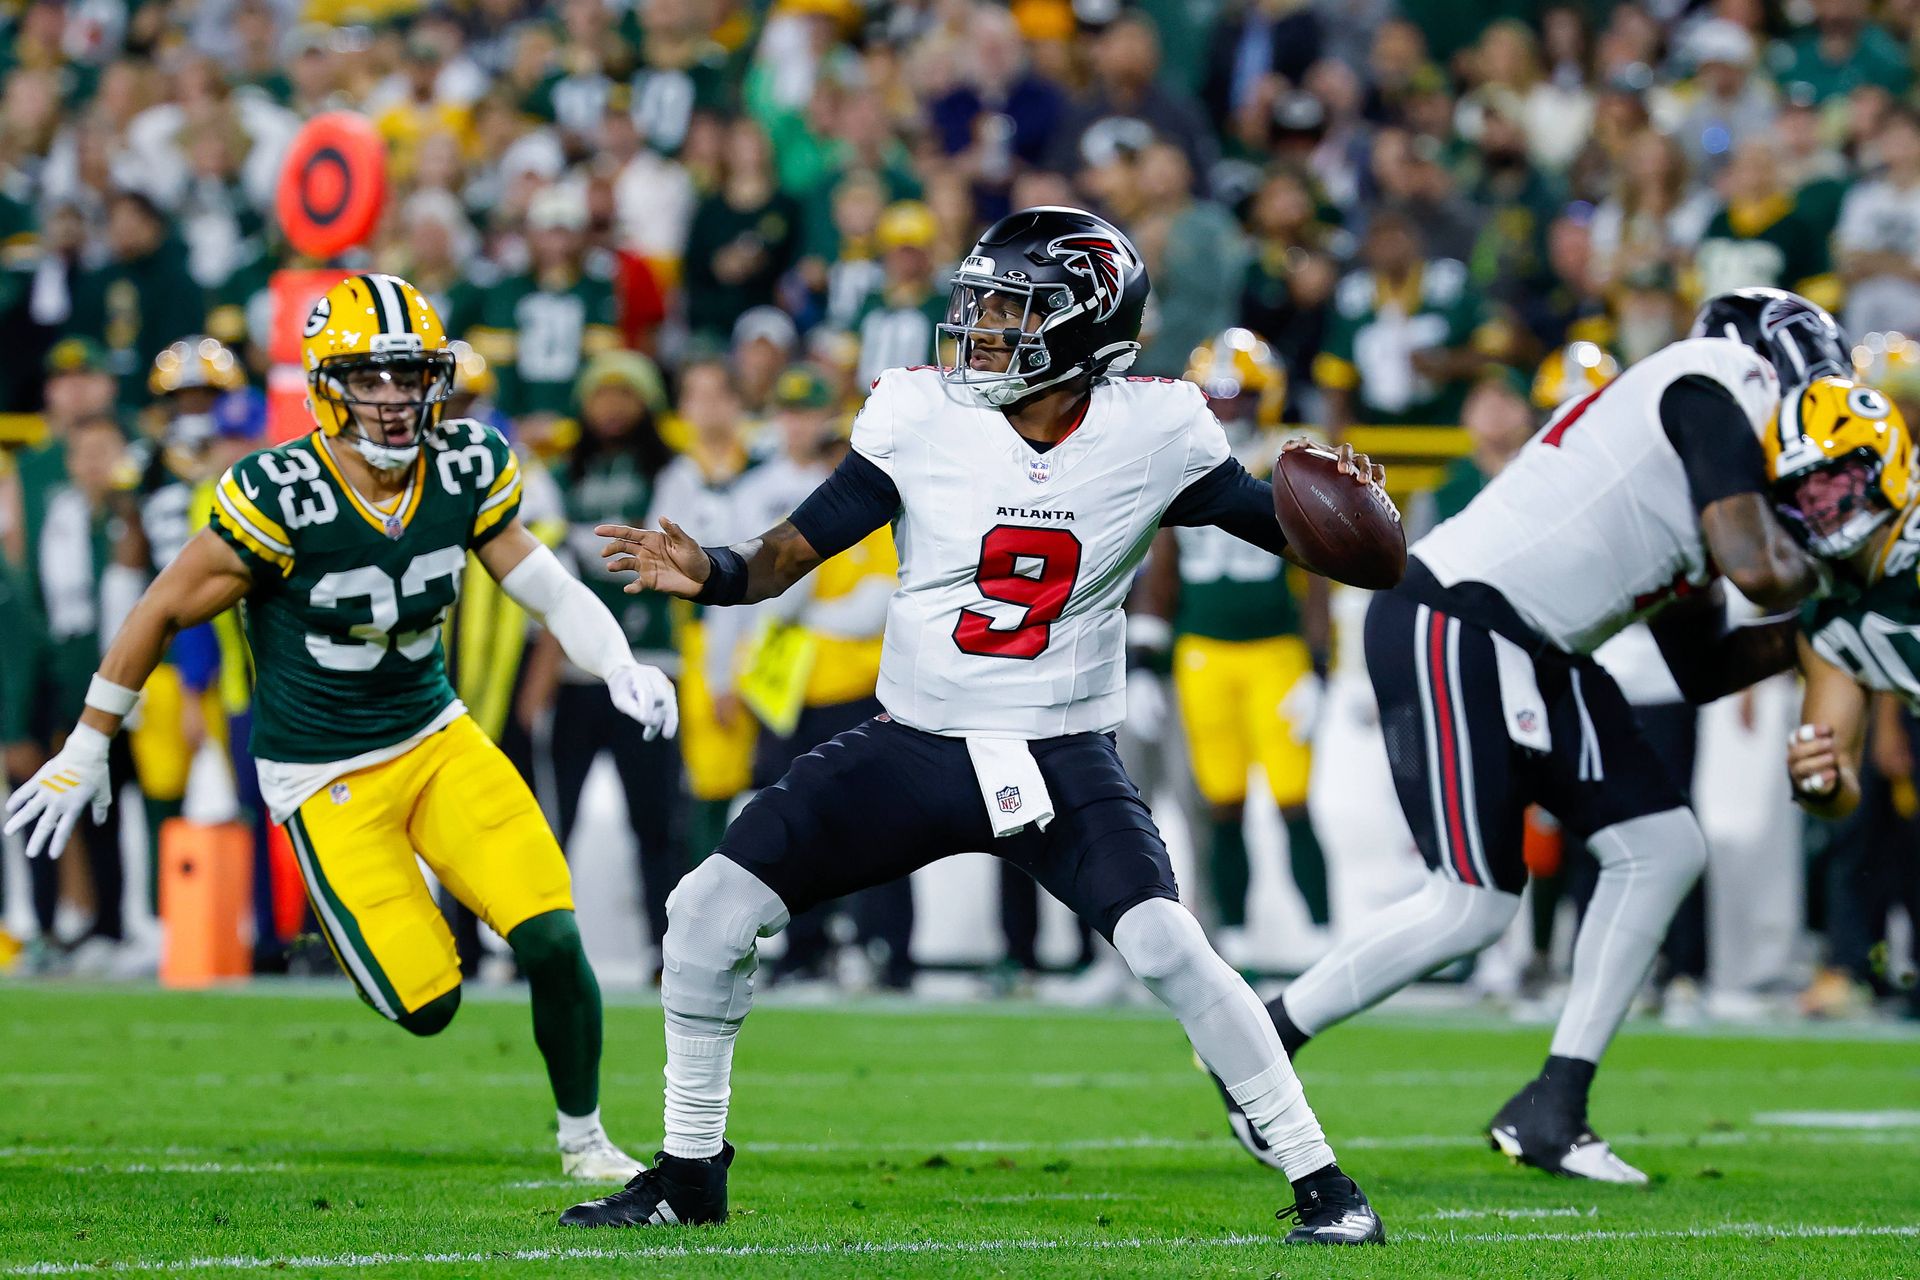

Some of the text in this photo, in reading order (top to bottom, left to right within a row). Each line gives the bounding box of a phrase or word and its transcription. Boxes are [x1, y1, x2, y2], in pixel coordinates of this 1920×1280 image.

[257, 447, 339, 531] 33
[996, 506, 1075, 521] ATLANTA
[1310, 484, 1337, 513] NATIONAL
[304, 544, 467, 672] 33
[951, 523, 1083, 661] 9
[1001, 796, 1020, 810] NFL
